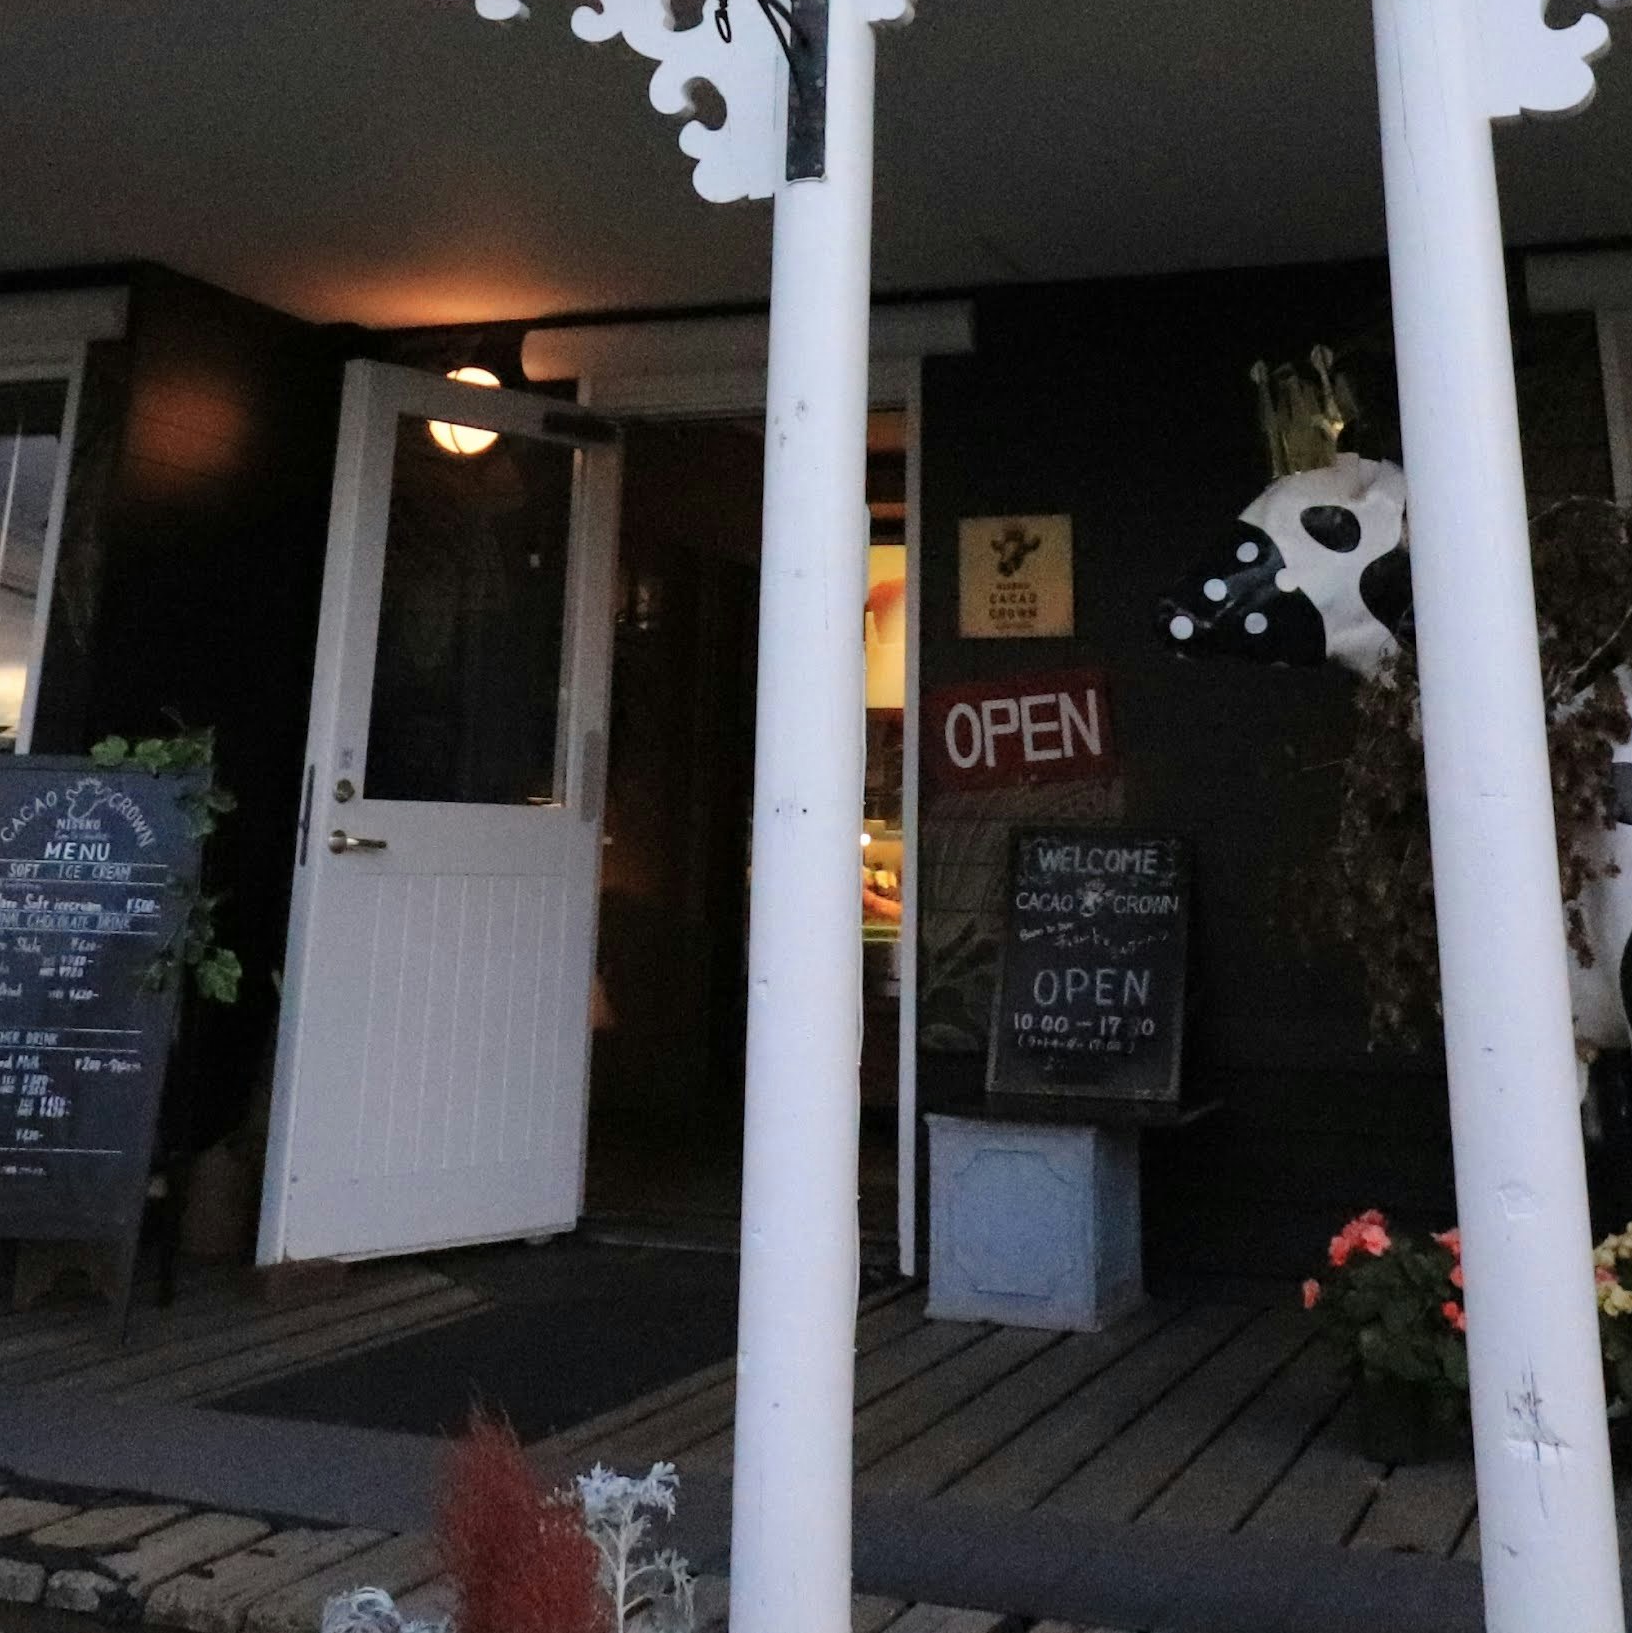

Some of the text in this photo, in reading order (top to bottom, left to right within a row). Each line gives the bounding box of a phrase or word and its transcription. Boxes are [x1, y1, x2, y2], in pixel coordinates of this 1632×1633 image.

[989, 592, 1038, 604] CACAO
[989, 608, 1037, 620] CROWN
[945, 689, 1102, 768] OPEN
[0, 791, 156, 848] CACAO CROWN
[44, 842, 110, 861] MENU
[1038, 846, 1158, 874] WELCOME
[8, 863, 131, 880] SOFT ICE CREAM
[1016, 892, 1179, 915] CACAO CROWN
[1033, 967, 1150, 1007] OPEN
